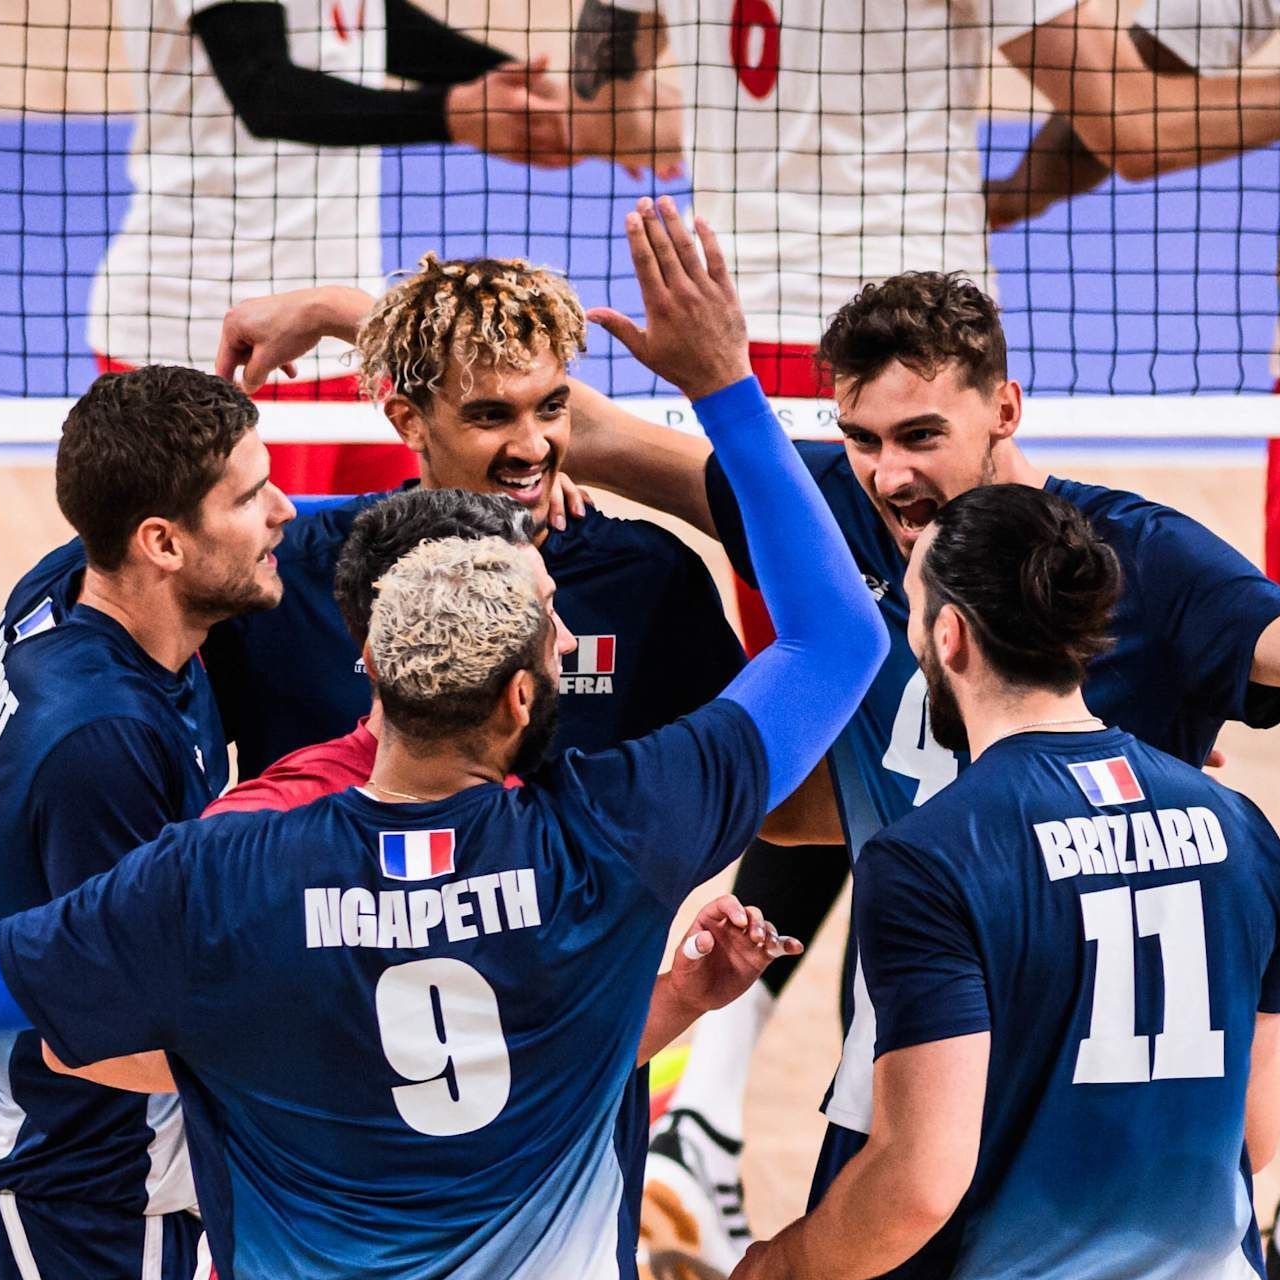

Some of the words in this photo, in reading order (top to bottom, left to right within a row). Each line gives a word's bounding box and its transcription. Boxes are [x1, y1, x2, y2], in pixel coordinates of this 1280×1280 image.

[558, 676, 614, 695] FRA
[1032, 806, 1228, 882] BRIZARD
[304, 868, 542, 949] NGAPETH
[1072, 880, 1225, 1084] 11
[375, 957, 511, 1136] 9
